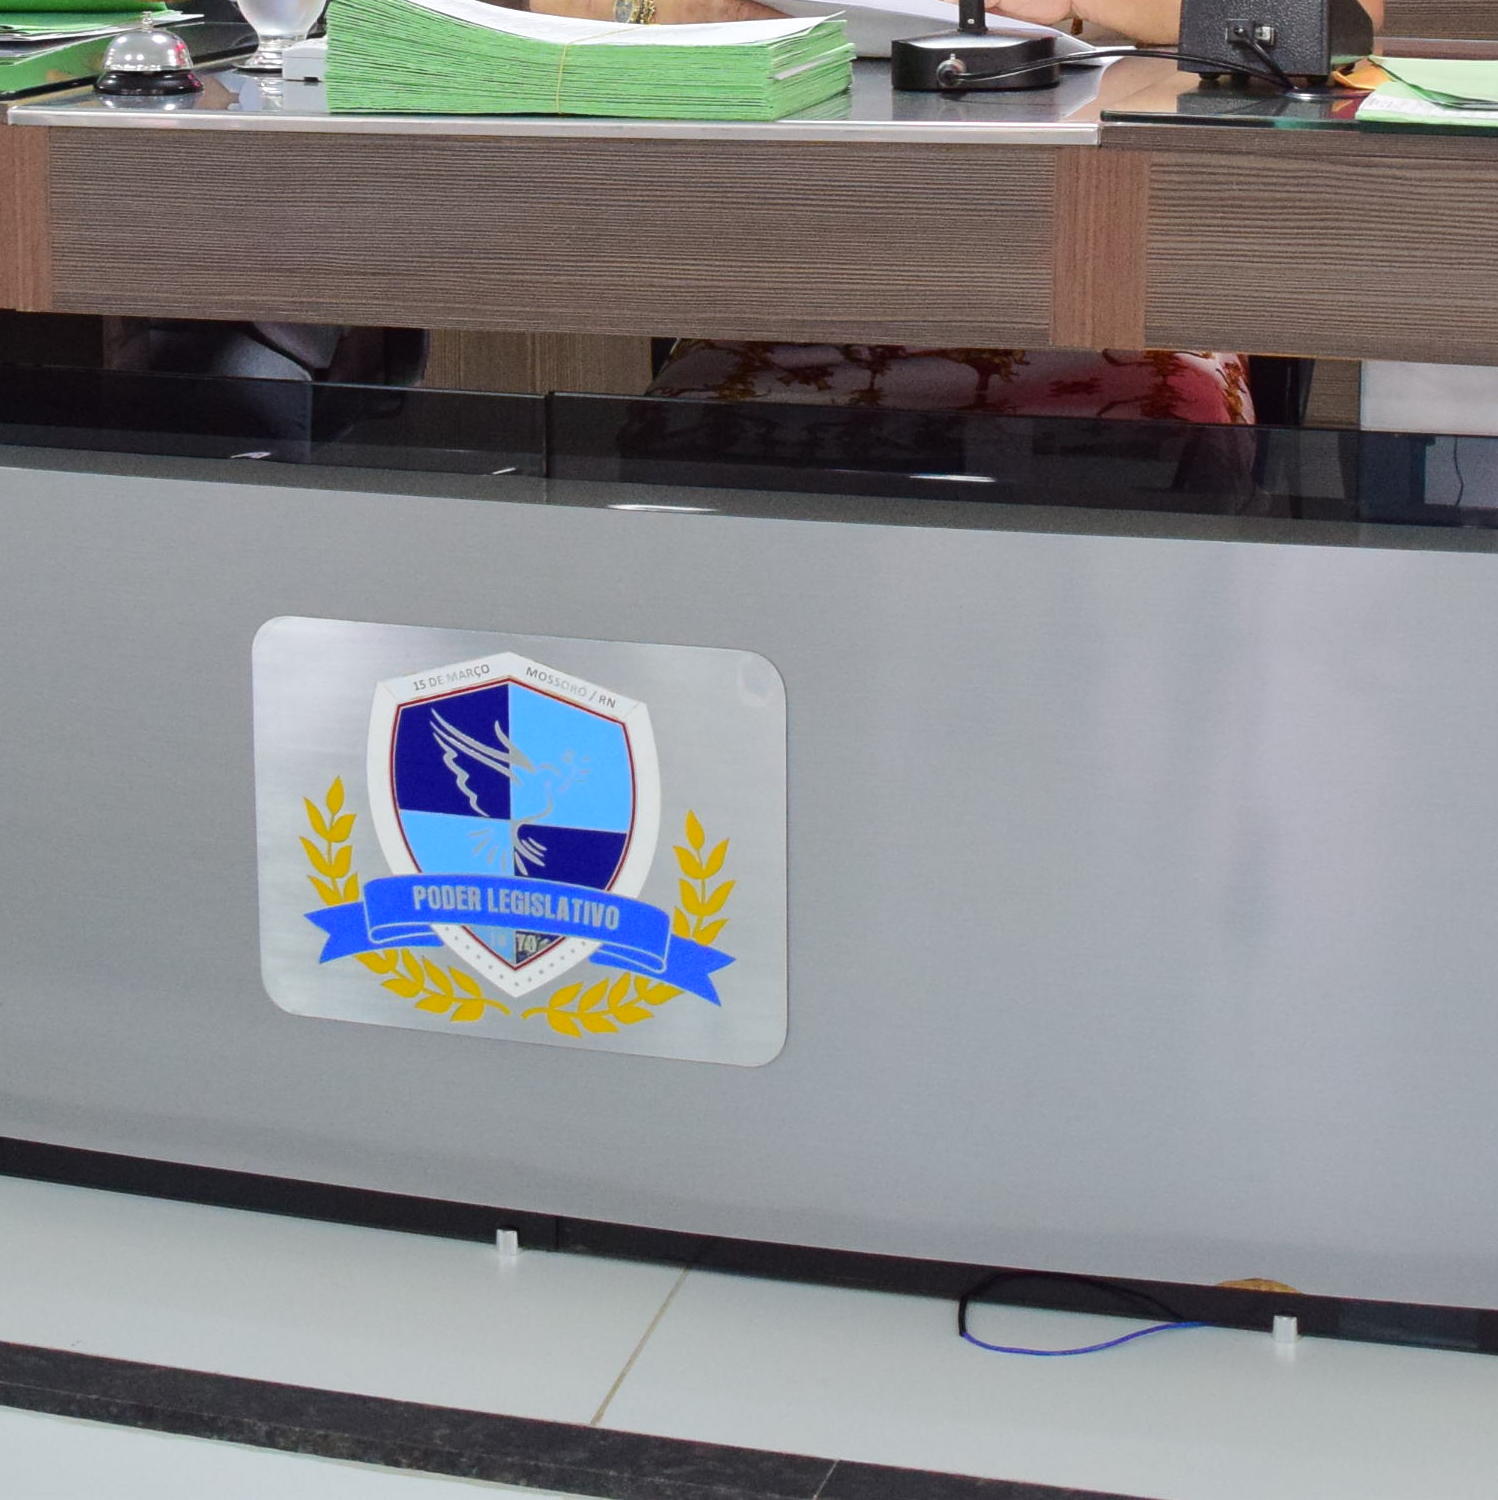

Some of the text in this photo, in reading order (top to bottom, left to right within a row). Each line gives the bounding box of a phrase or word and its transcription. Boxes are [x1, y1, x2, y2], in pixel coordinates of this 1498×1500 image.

[412, 680, 427, 691] 15
[428, 675, 444, 688] DE
[598, 694, 617, 709] RN
[412, 884, 621, 931] PODER LEGISLATIVO
